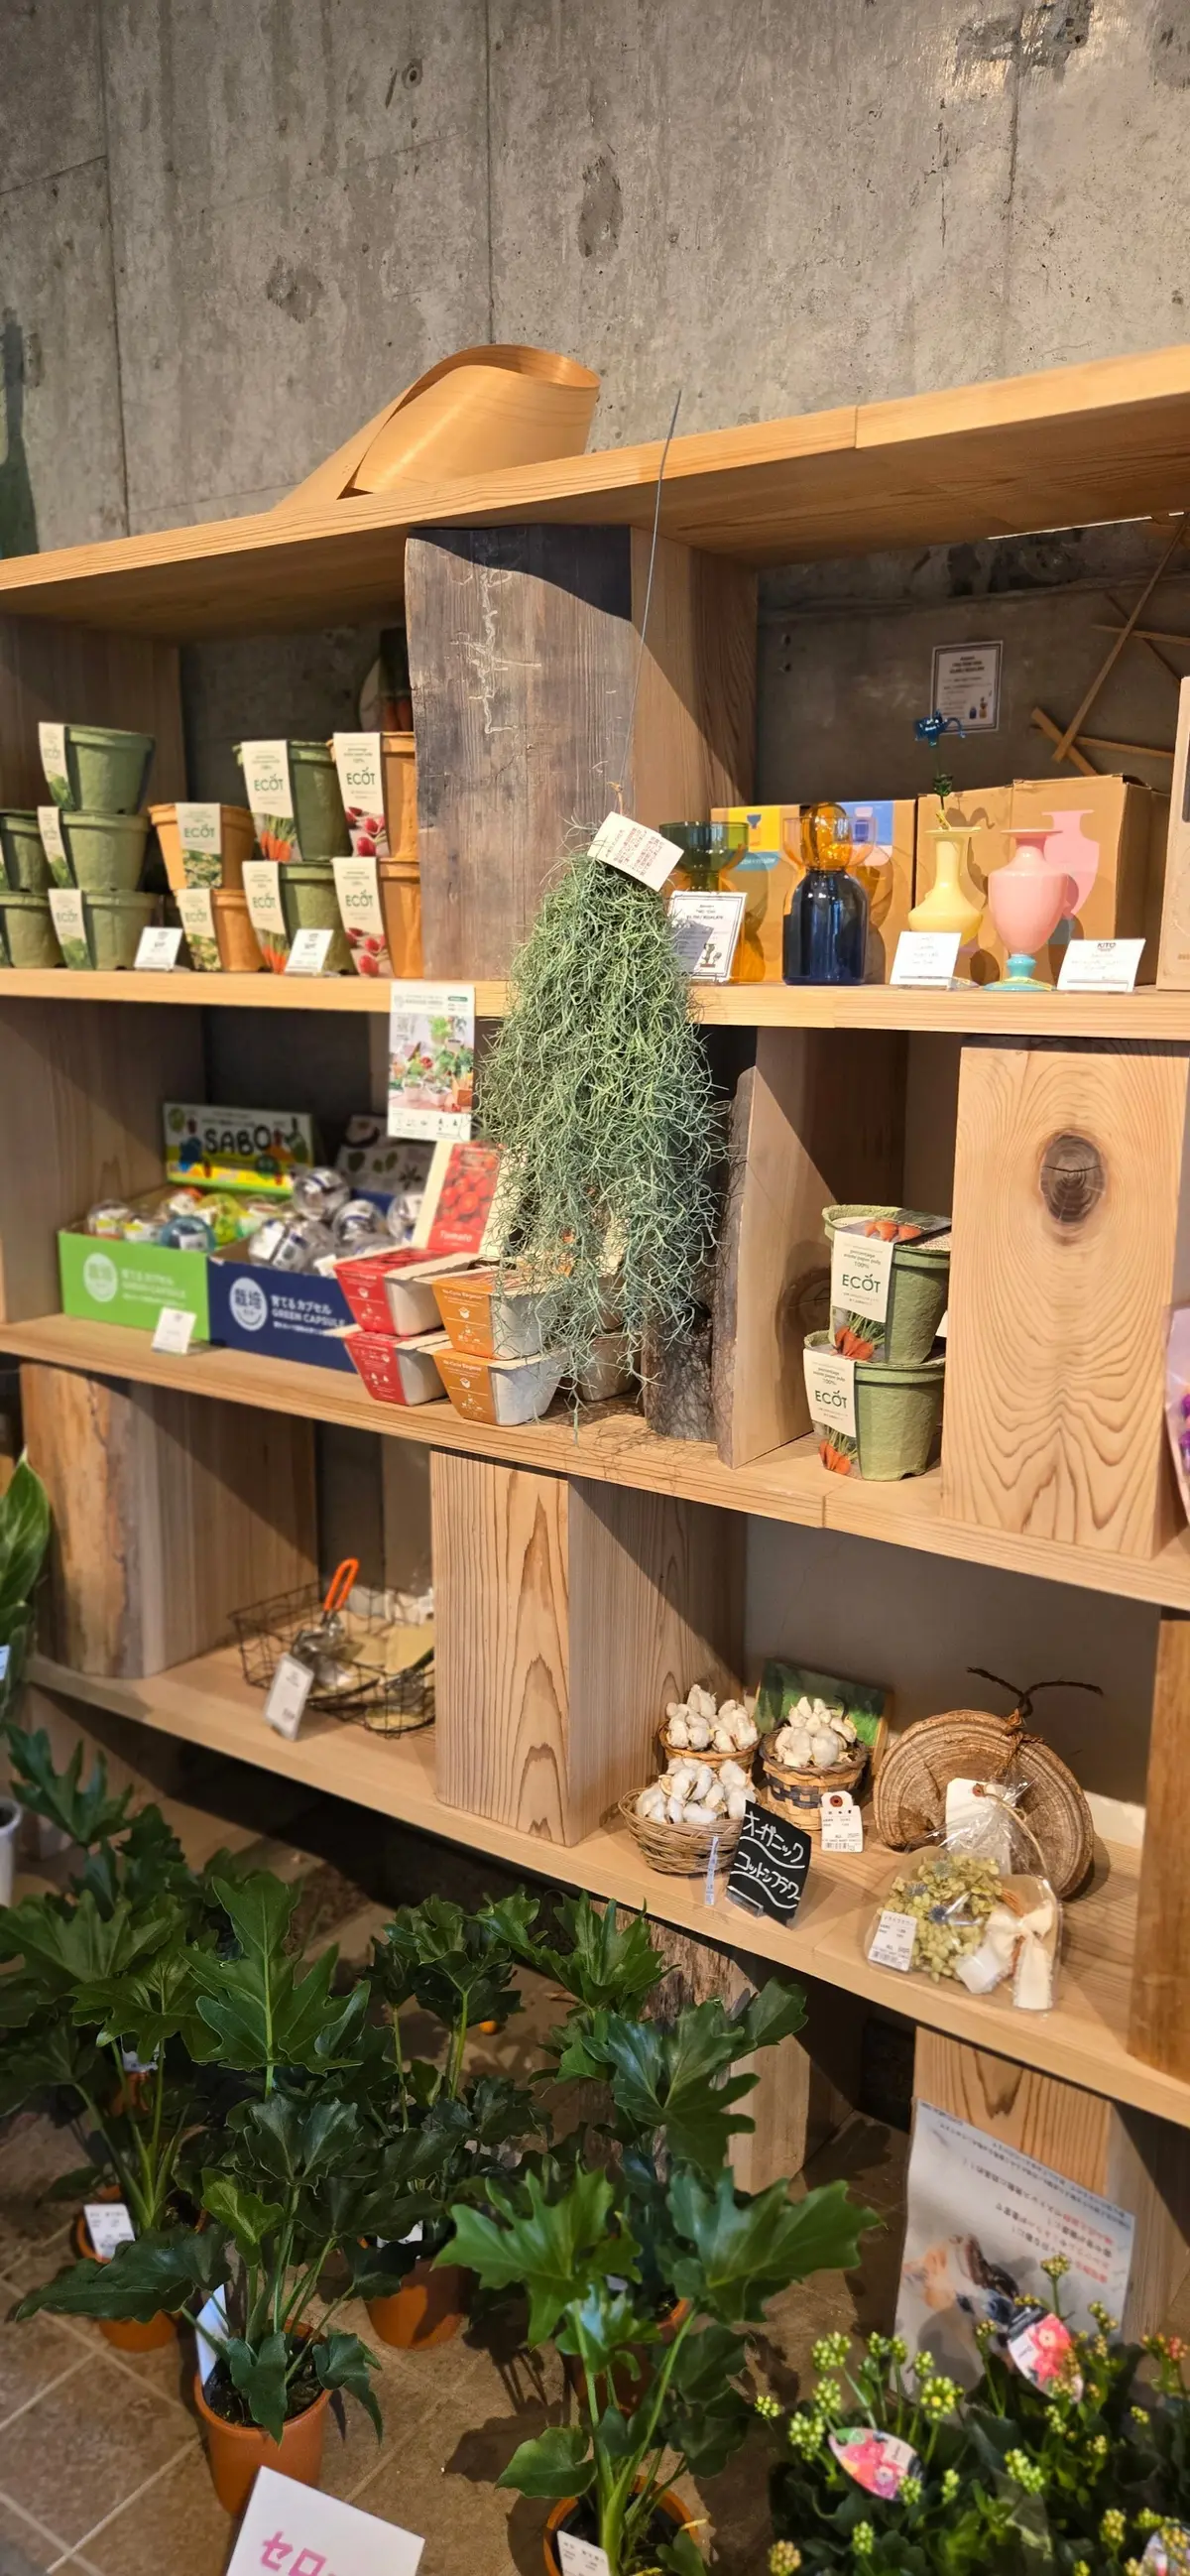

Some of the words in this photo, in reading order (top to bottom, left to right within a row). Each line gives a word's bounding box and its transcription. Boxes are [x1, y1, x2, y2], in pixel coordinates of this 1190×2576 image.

[743, 1810, 804, 1864] オーガニック
